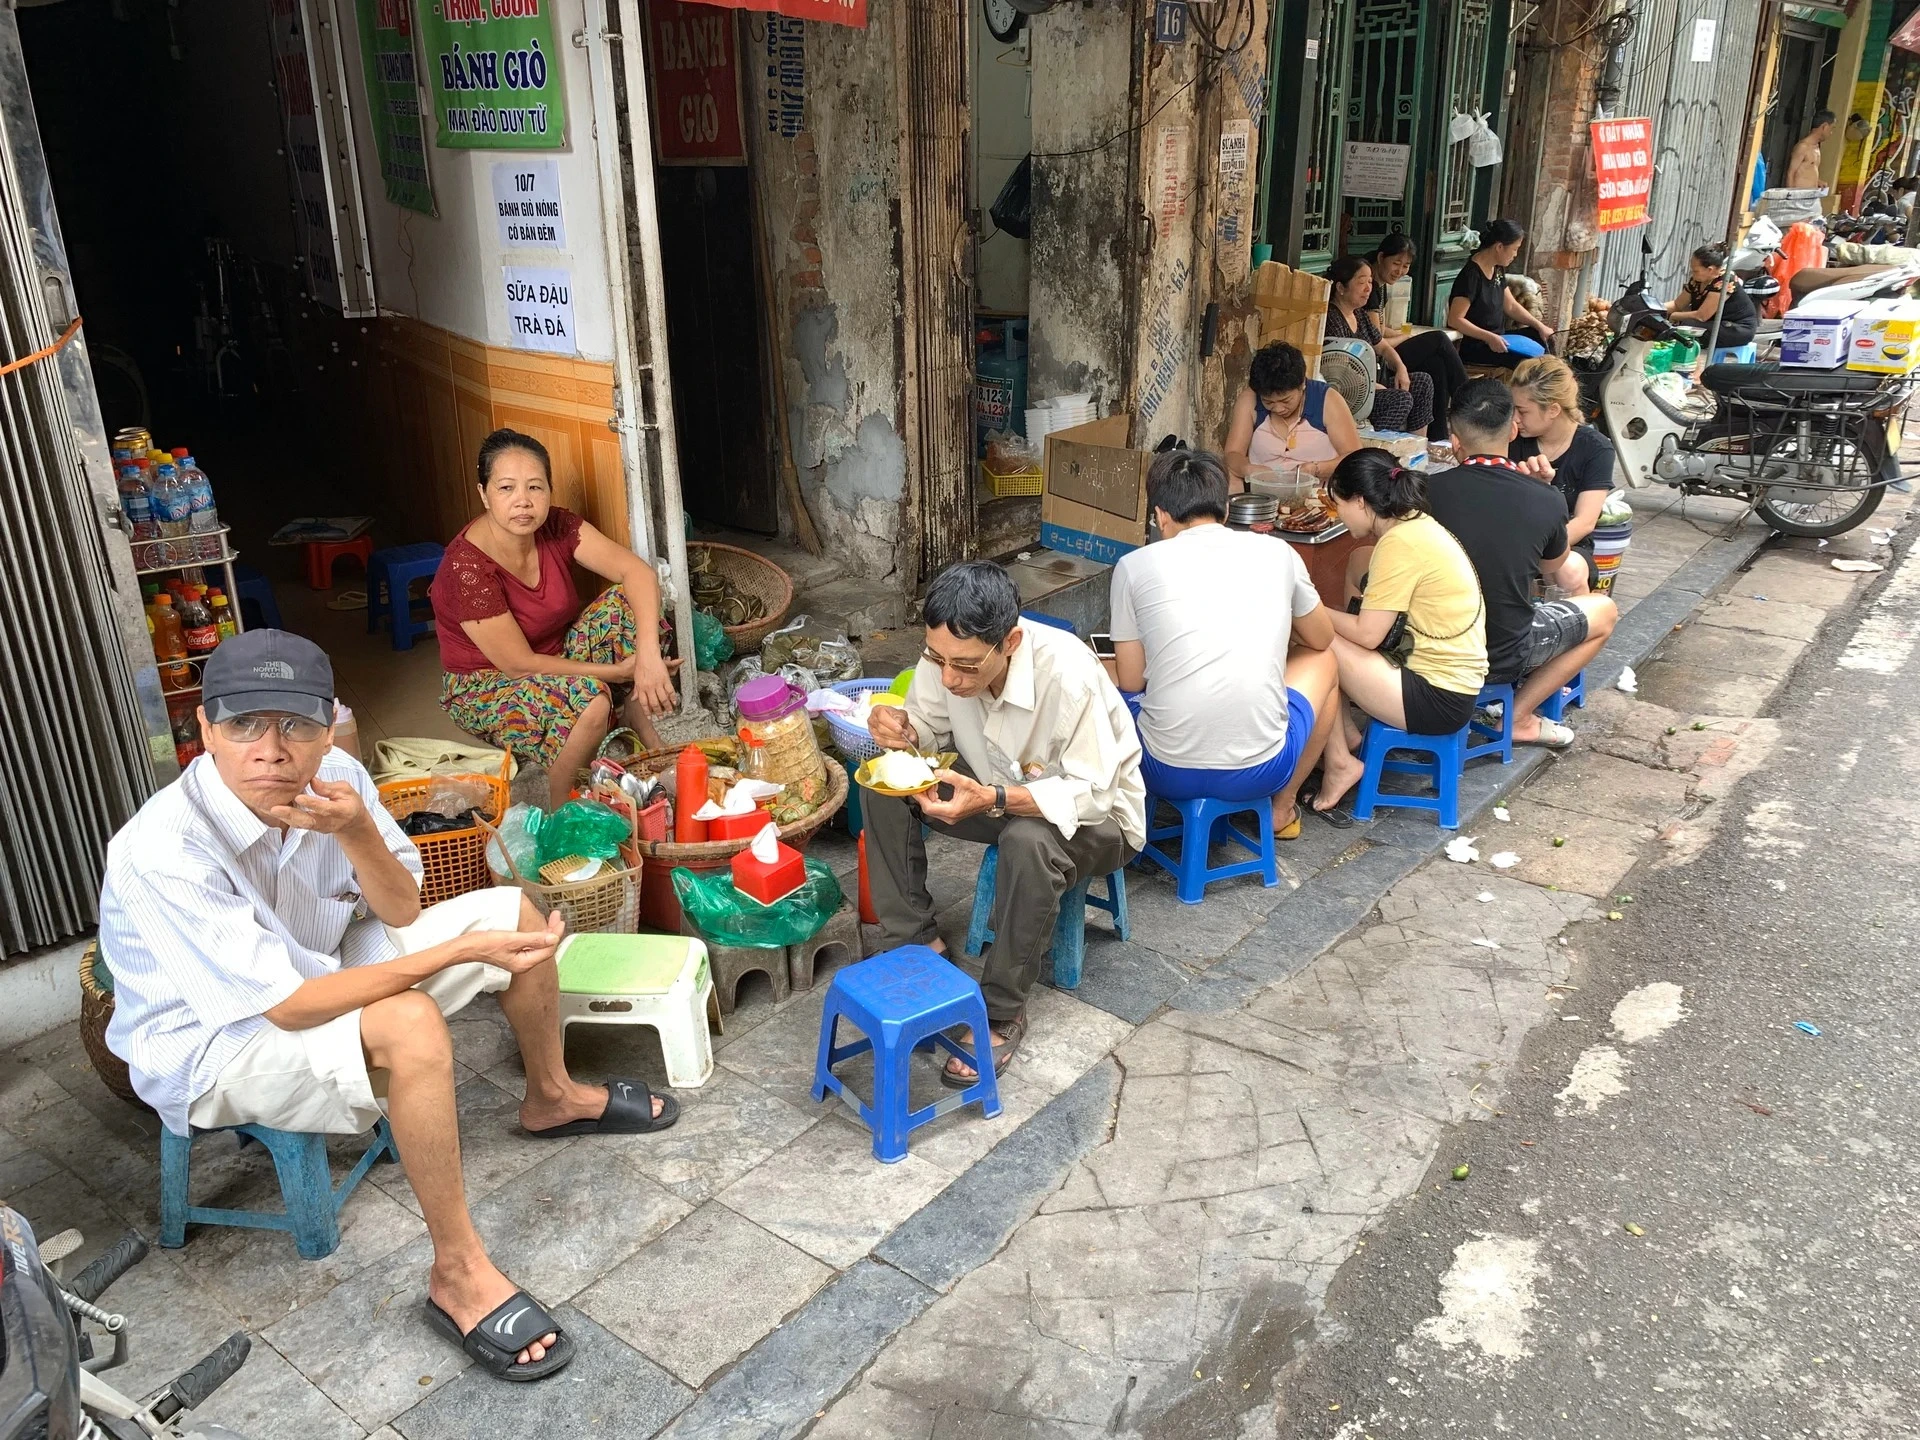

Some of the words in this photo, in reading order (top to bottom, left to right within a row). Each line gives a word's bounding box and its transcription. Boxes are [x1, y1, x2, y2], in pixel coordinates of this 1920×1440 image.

[1163, 6, 1180, 36] 16
[659, 2, 727, 71] BÁNH
[439, 42, 500, 91] BÁNH
[502, 38, 547, 90] GIÒ
[448, 108, 470, 133] MAI
[471, 103, 498, 133] ĐÀO
[499, 108, 526, 133] DUY
[528, 103, 547, 133] TỪ
[678, 78, 719, 144] GIÒ
[514, 173, 535, 192] 10/7
[498, 200, 520, 217] BÁNH
[521, 198, 534, 217] GIÒ
[535, 199, 559, 217] NÓNG
[508, 223, 519, 241] CÓ
[520, 223, 537, 241] BÁN
[538, 224, 556, 241] ĐÊM
[506, 280, 537, 302] SỮA
[540, 283, 568, 309] ĐẬU
[514, 314, 543, 335] TRÀ
[544, 315, 566, 337] ĐÁ
[1109, 470, 1127, 487] TV
[1095, 541, 1117, 559] TV
